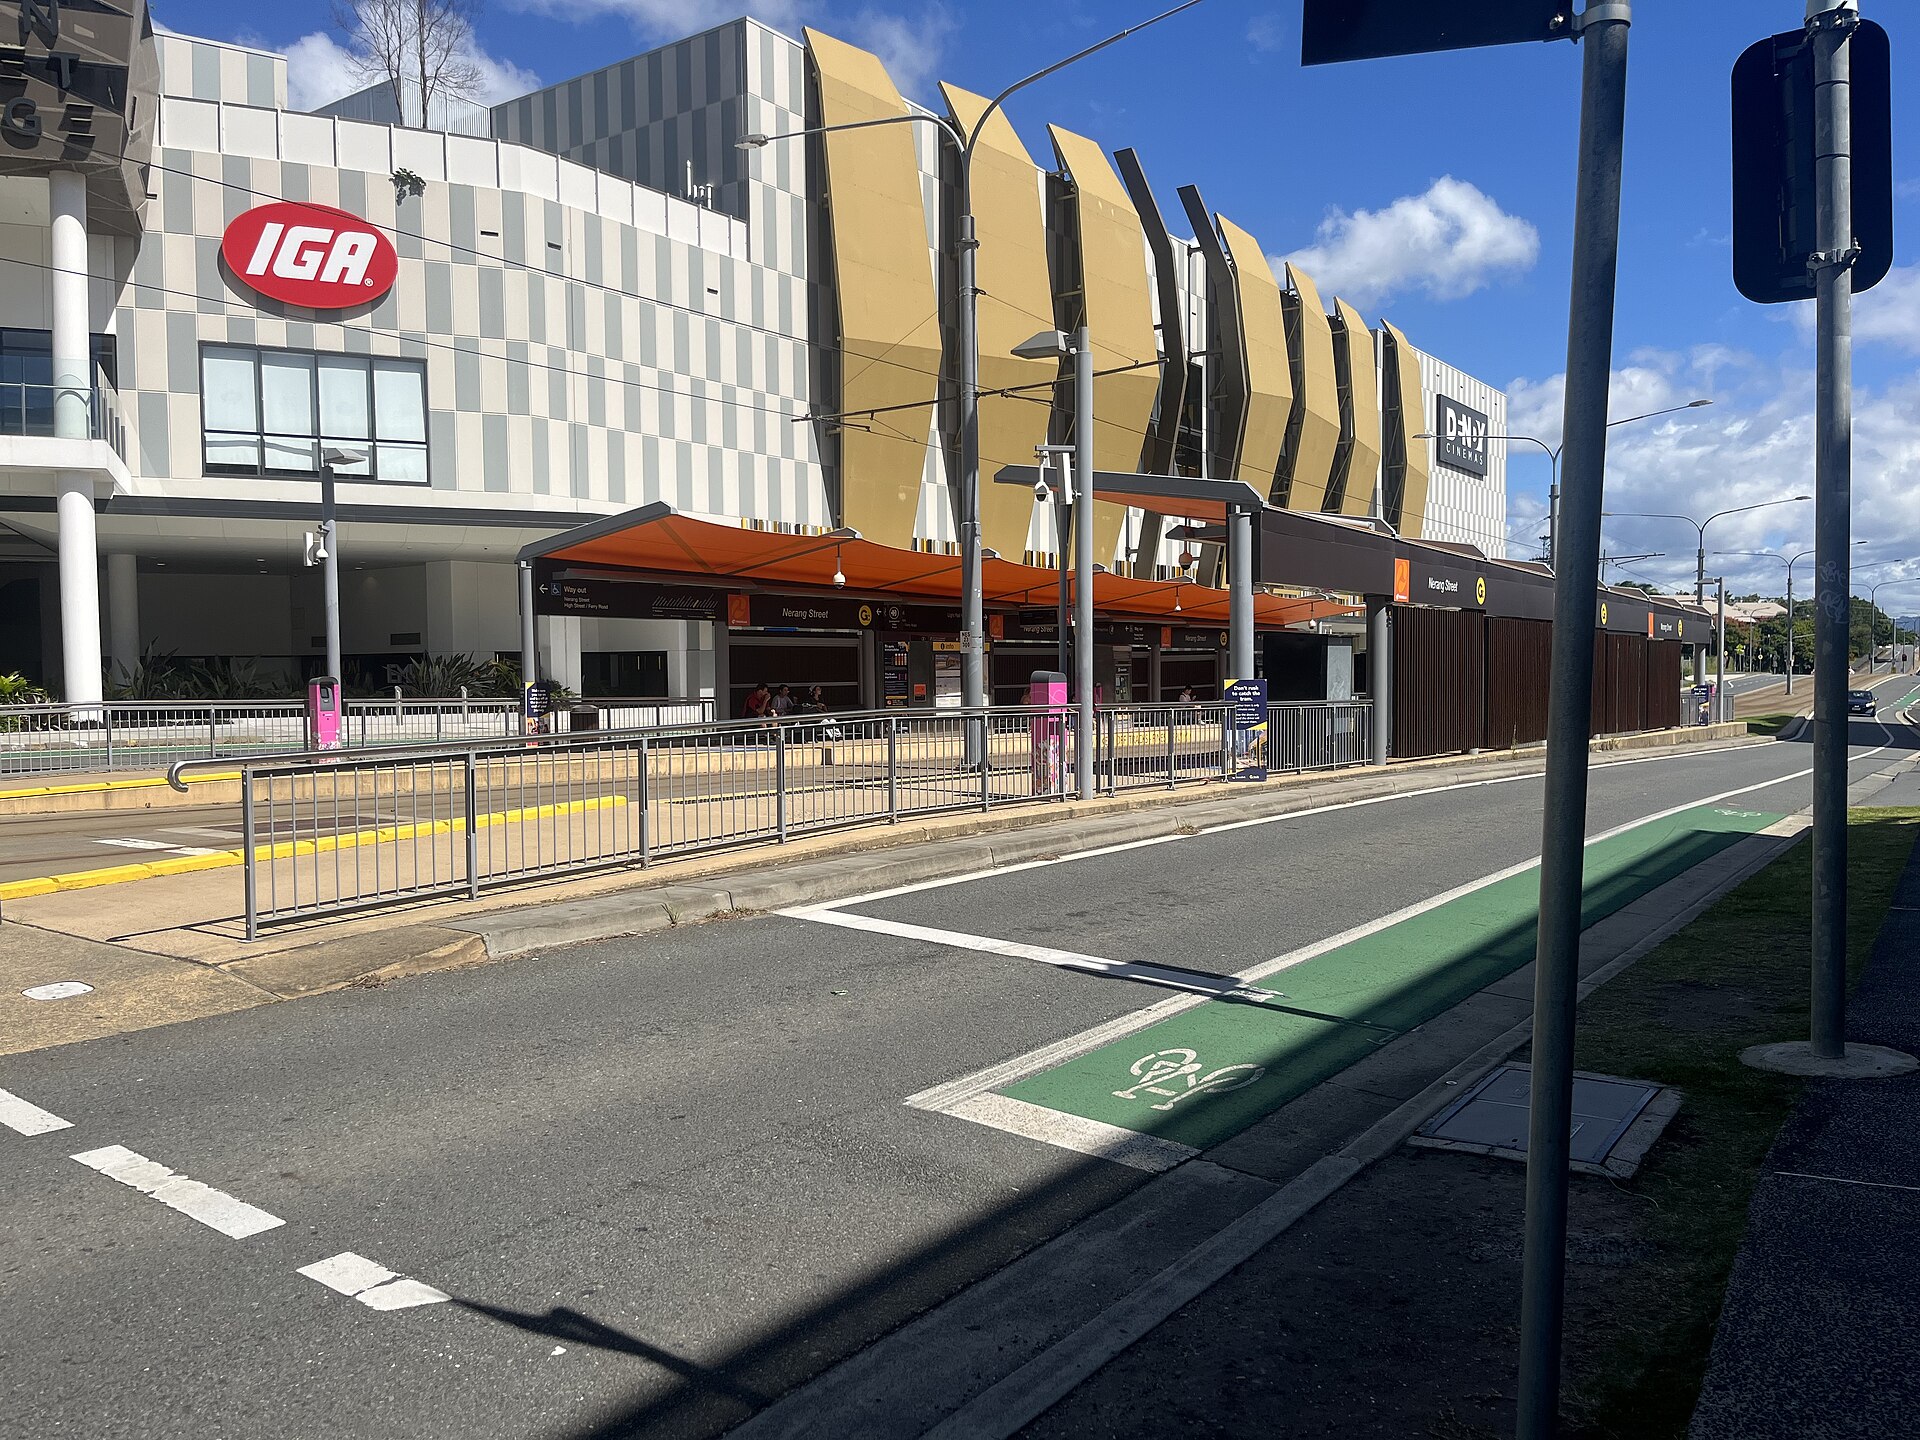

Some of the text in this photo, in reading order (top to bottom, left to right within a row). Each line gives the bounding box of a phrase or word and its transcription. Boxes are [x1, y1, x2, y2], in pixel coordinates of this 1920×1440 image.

[245, 222, 378, 286] IGA
[1446, 442, 1483, 466] CINEMAS
[563, 585, 577, 594] Way
[1428, 577, 1459, 593] Nerang Street
[782, 608, 829, 620] Nerang Street
